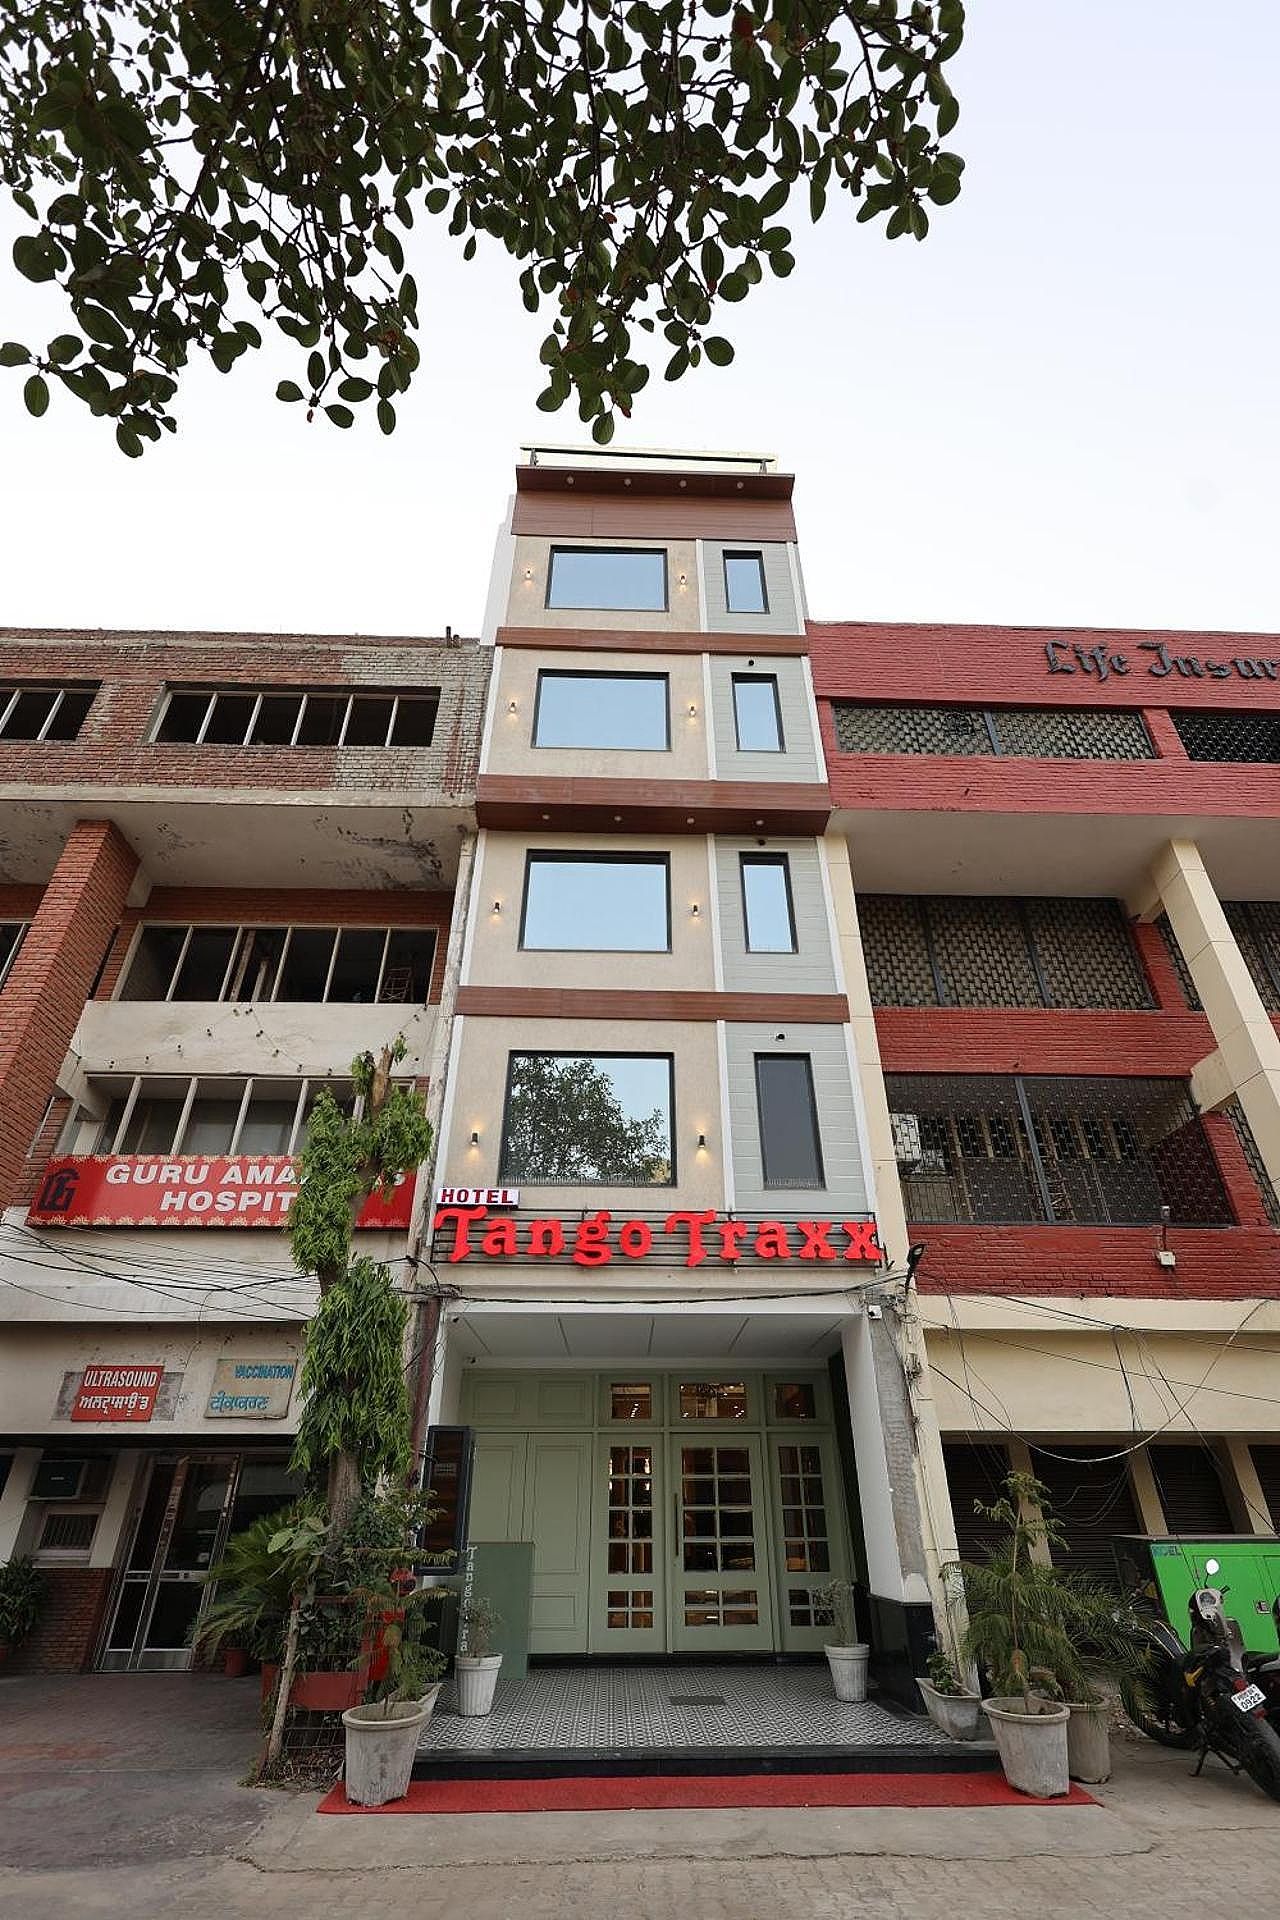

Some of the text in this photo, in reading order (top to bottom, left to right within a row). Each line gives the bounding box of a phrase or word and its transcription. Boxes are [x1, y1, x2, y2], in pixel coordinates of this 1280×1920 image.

[1045, 639, 1130, 681] Life
[105, 1163, 311, 1186] GURU AMA
[159, 1191, 297, 1212] HOSPIT
[440, 1188, 514, 1205] HOTEL
[434, 1206, 883, 1268] Tango Traxx
[83, 1370, 158, 1388] ULTRASOUND
